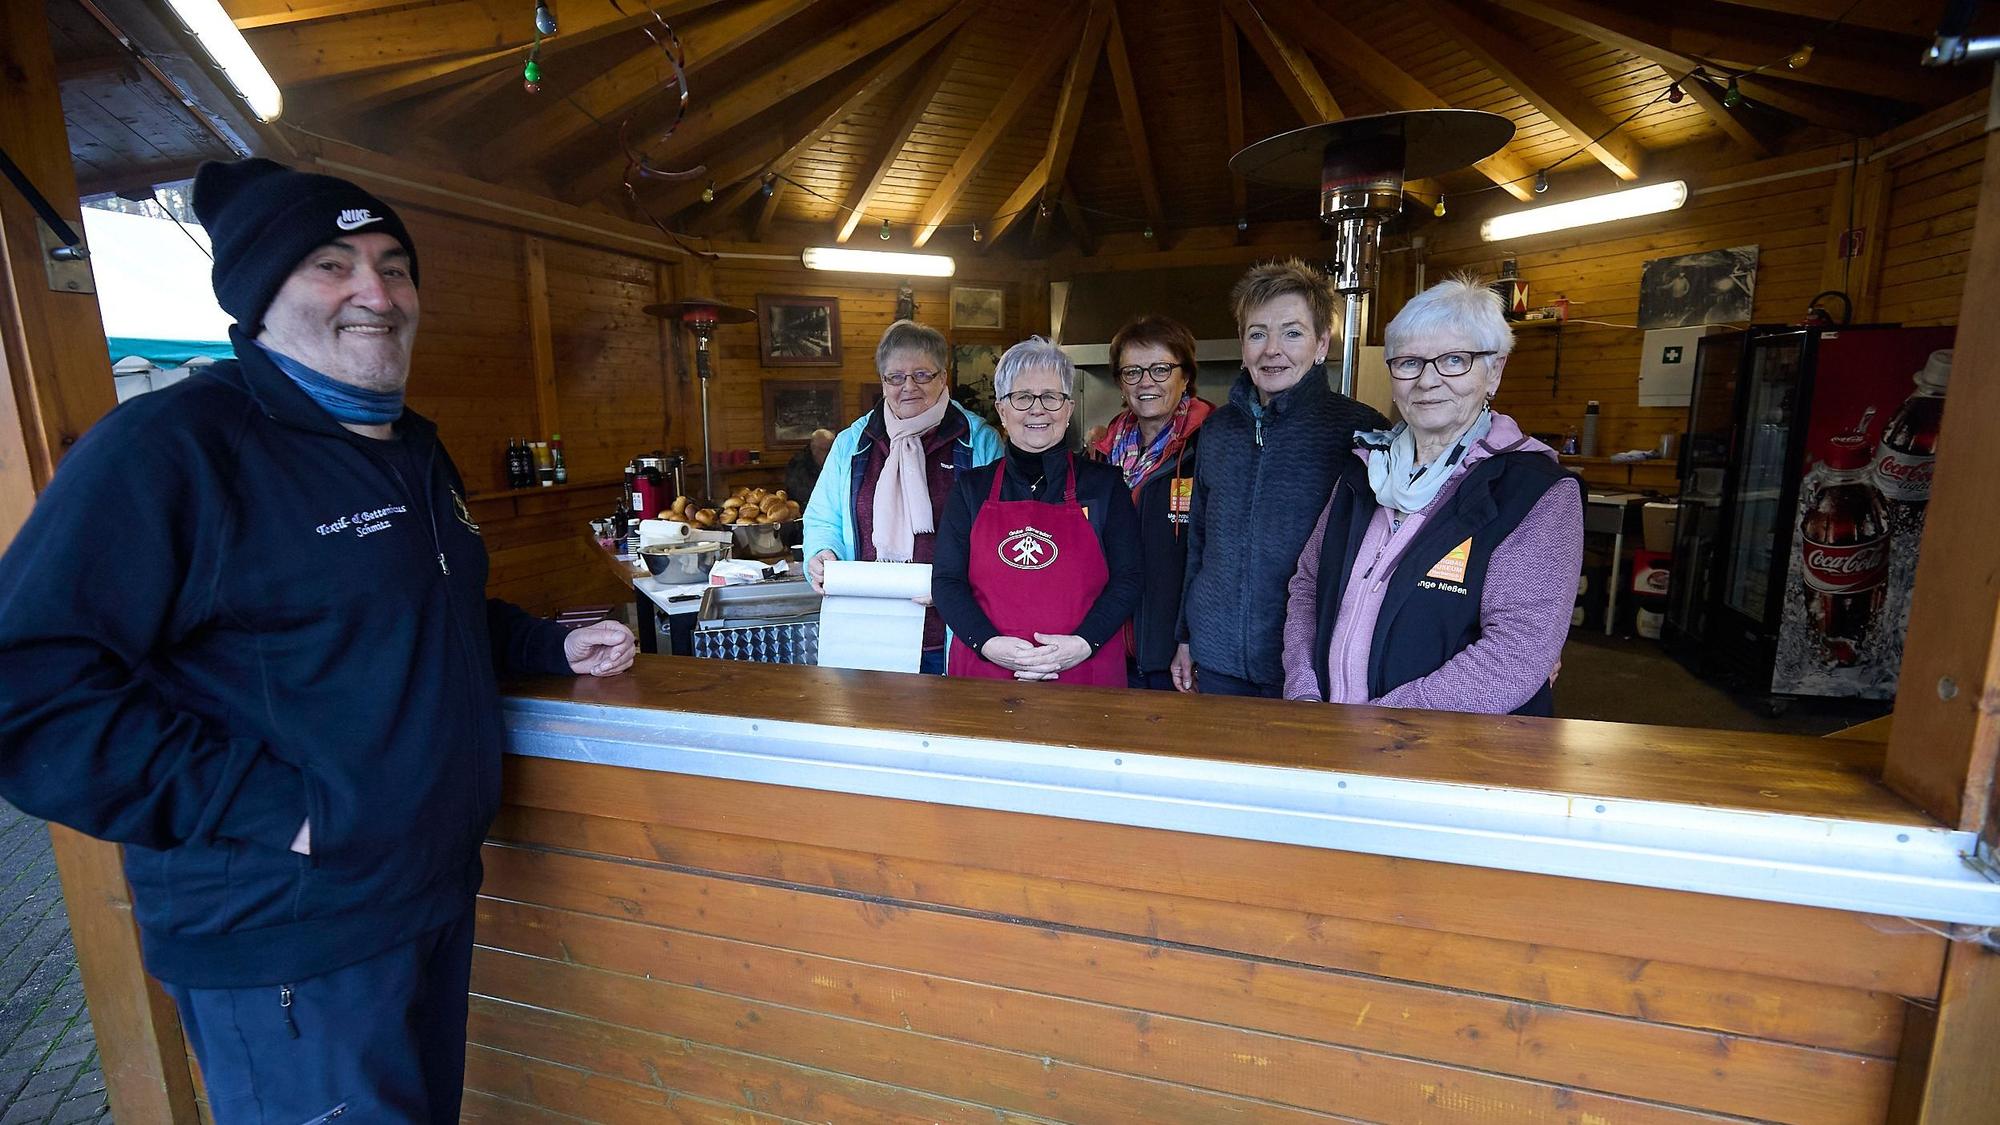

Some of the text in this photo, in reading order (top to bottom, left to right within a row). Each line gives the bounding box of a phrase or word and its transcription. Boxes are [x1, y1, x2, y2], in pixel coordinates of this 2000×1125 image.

[341, 209, 371, 222] NIKE
[316, 516, 351, 536] Textil-
[356, 521, 392, 538] Schmitz
[1808, 548, 1881, 574] Coca-Cola
